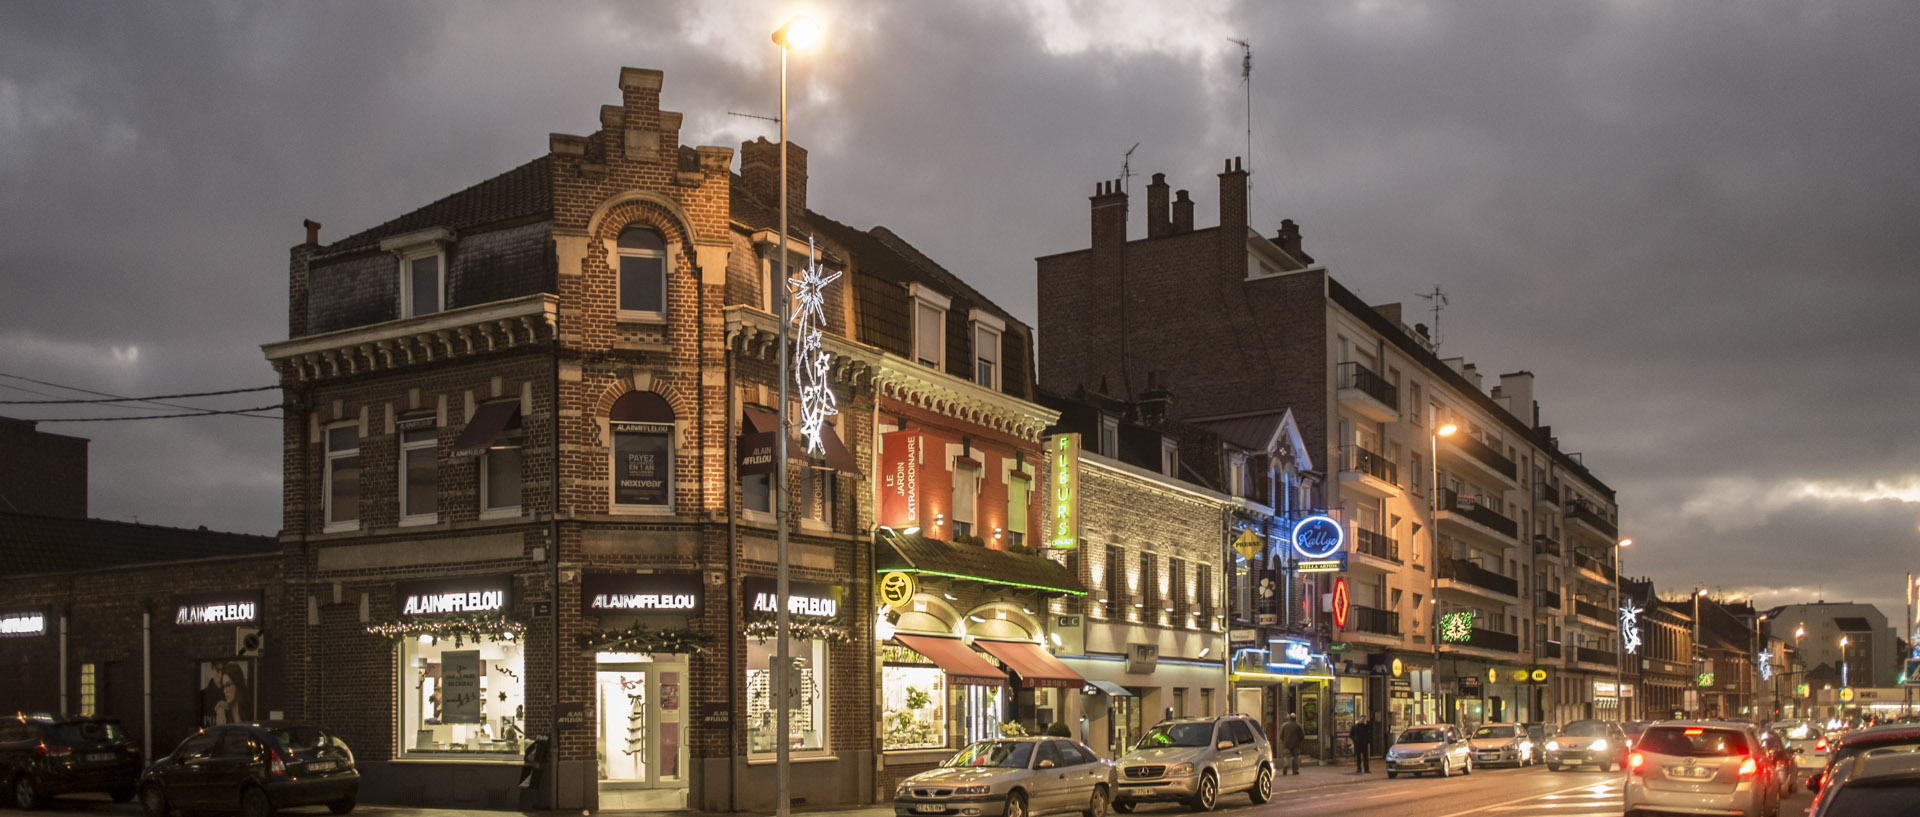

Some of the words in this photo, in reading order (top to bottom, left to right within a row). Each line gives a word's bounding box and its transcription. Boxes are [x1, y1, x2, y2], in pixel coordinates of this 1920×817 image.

[752, 446, 772, 455] ALAIN
[629, 454, 655, 462] PAYEZ
[742, 455, 772, 465] AFFLELOU
[886, 474, 894, 487] LE
[907, 436, 915, 520] EXTRAORDINAIRE
[1057, 437, 1069, 536] FLEURS
[1299, 529, 1338, 552] Rallye
